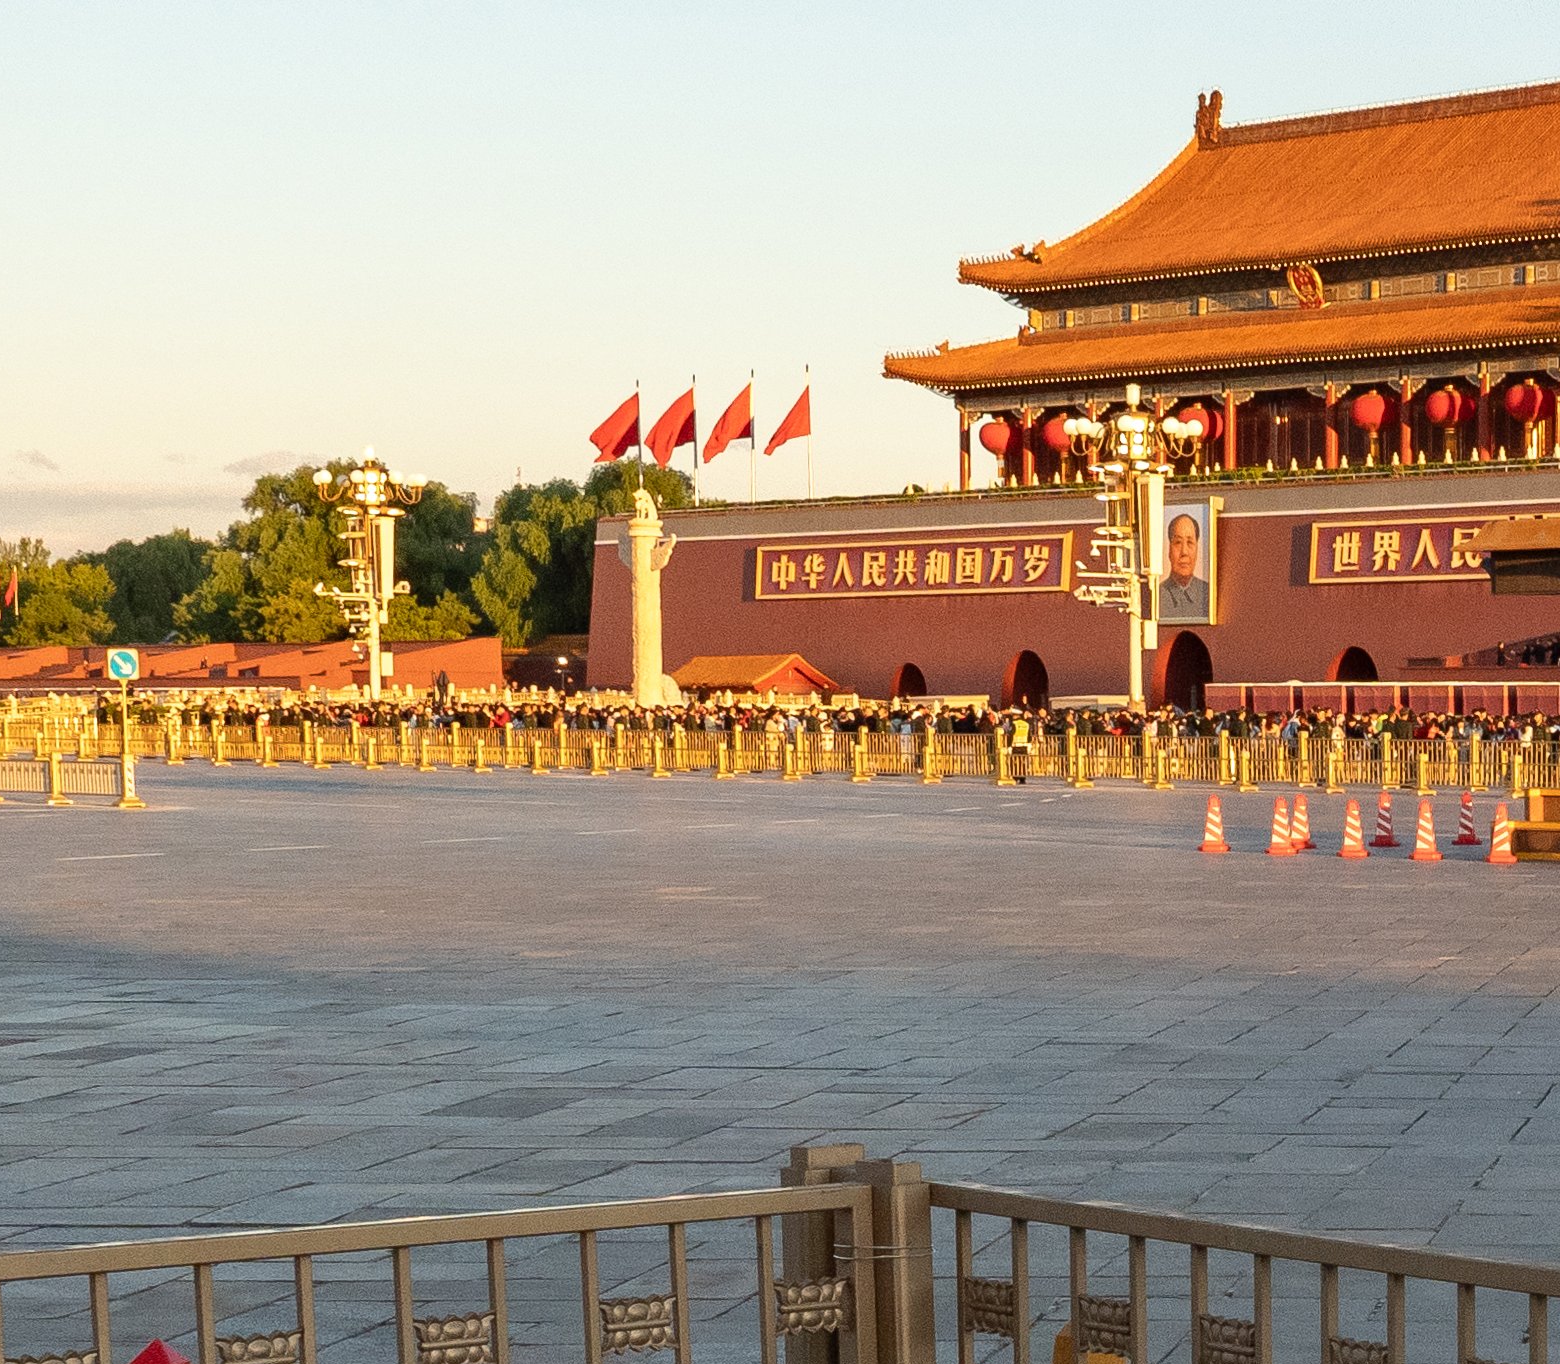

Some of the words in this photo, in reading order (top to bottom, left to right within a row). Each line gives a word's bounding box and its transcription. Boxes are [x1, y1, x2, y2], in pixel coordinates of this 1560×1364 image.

[771, 544, 1050, 590] 中华人民共和国万岁
